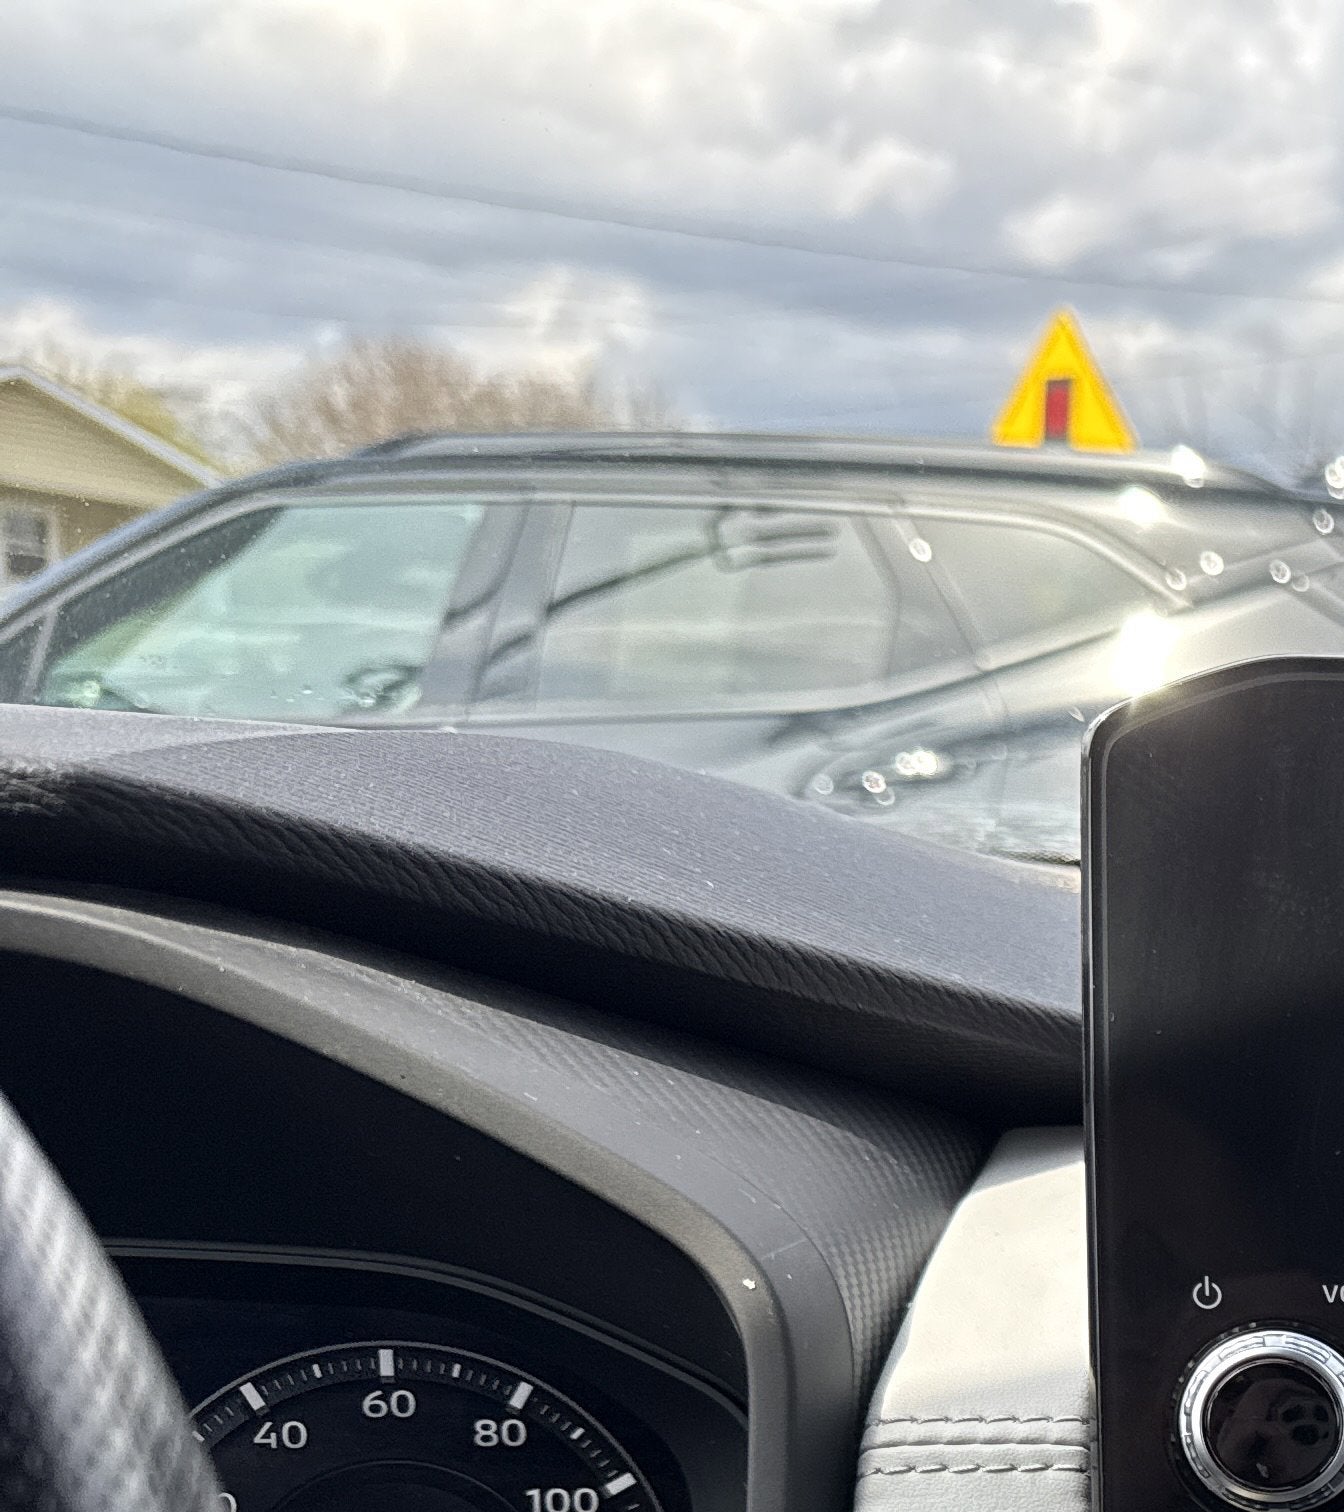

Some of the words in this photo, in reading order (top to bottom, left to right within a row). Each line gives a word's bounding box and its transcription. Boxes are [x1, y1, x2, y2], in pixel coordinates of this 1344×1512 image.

[362, 1391, 416, 1417] 60
[253, 1421, 308, 1448] 40
[473, 1419, 527, 1446] 80
